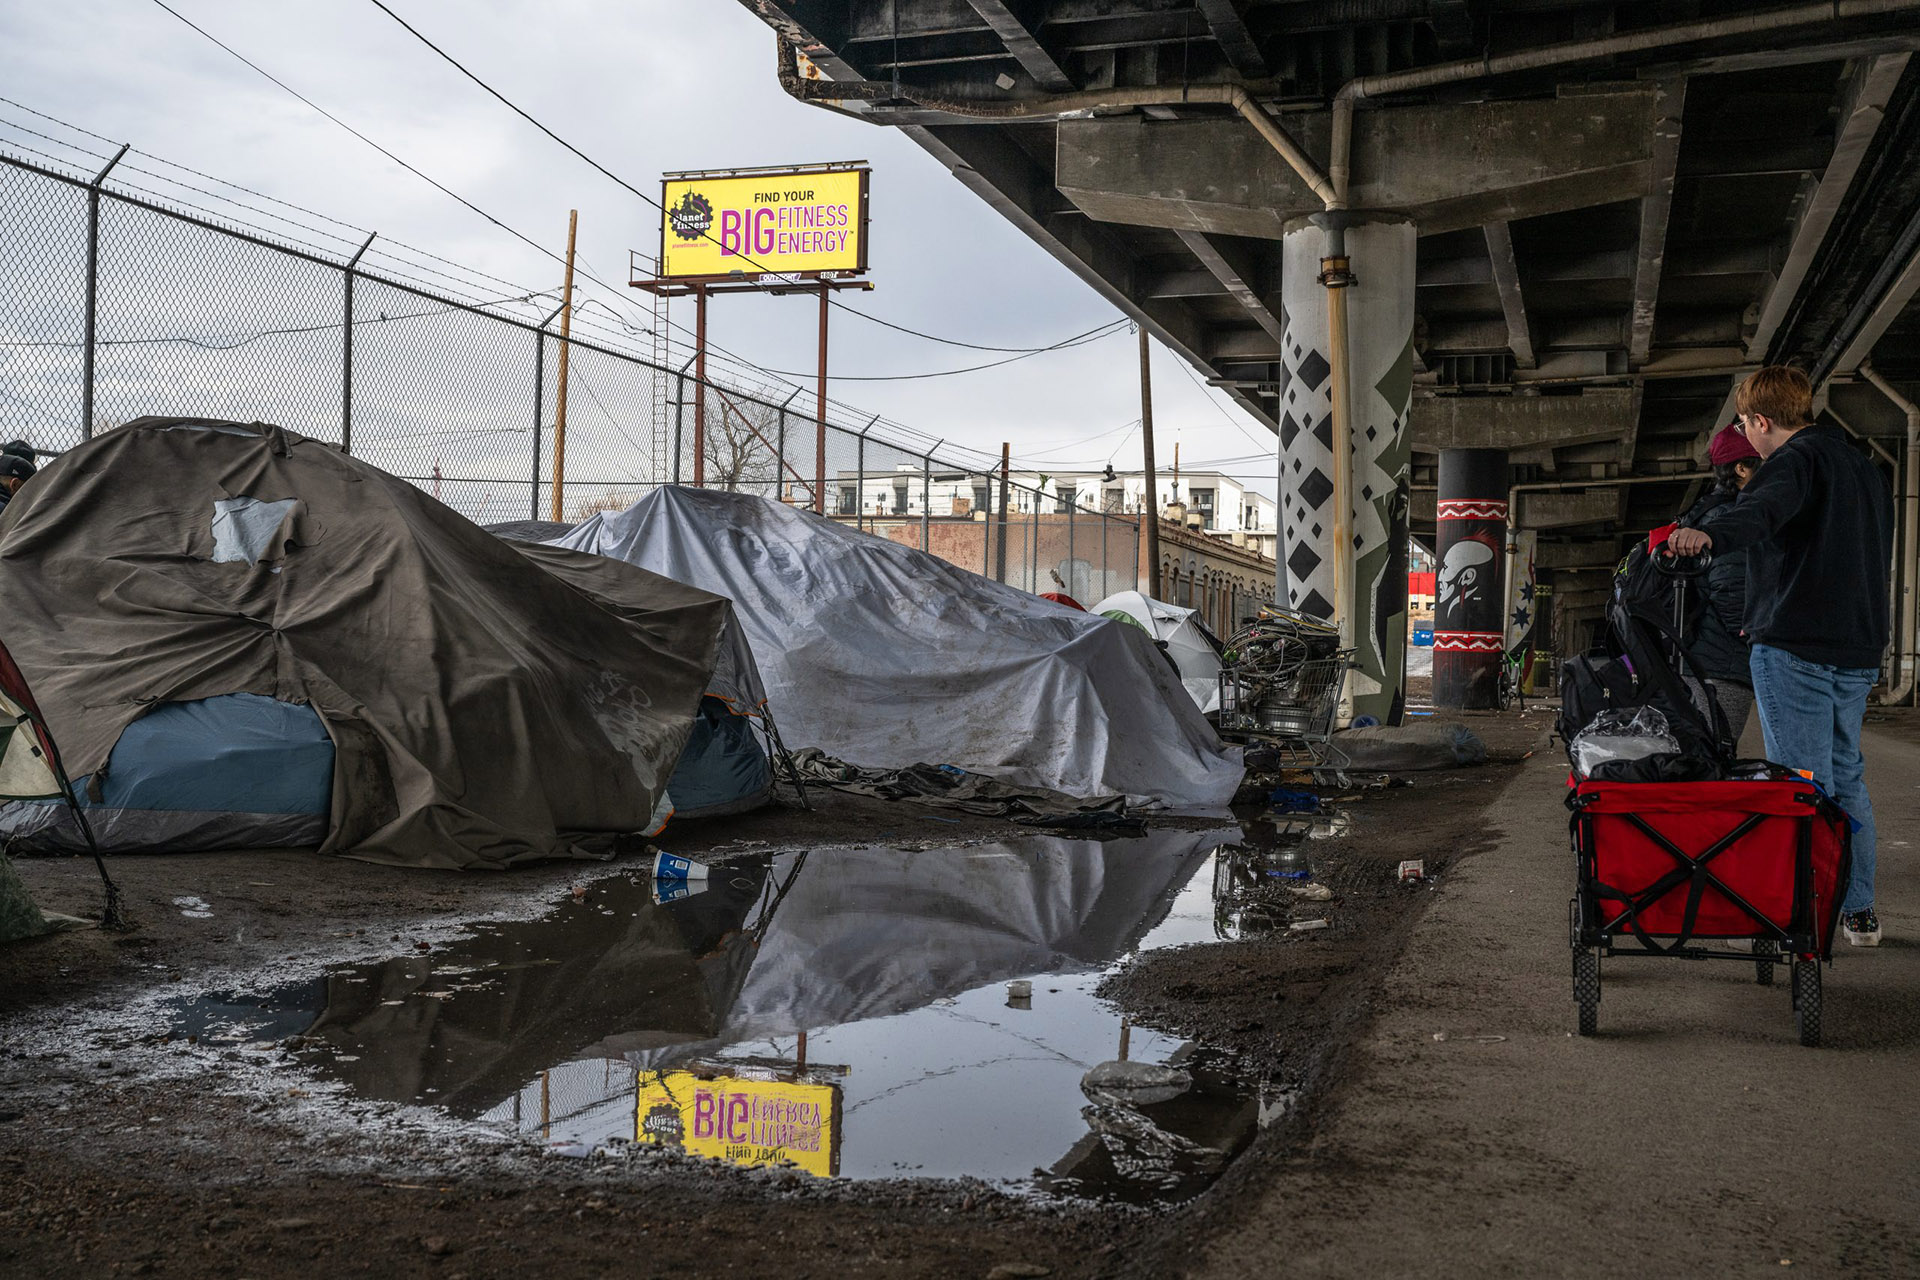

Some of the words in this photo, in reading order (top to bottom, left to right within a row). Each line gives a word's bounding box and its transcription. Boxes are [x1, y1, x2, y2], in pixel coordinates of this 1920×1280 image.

[754, 192, 780, 203] FIND
[783, 190, 814, 202] YOUR
[778, 204, 848, 229] FITNESS
[720, 208, 775, 256] BIG
[778, 230, 848, 254] ENERGY
